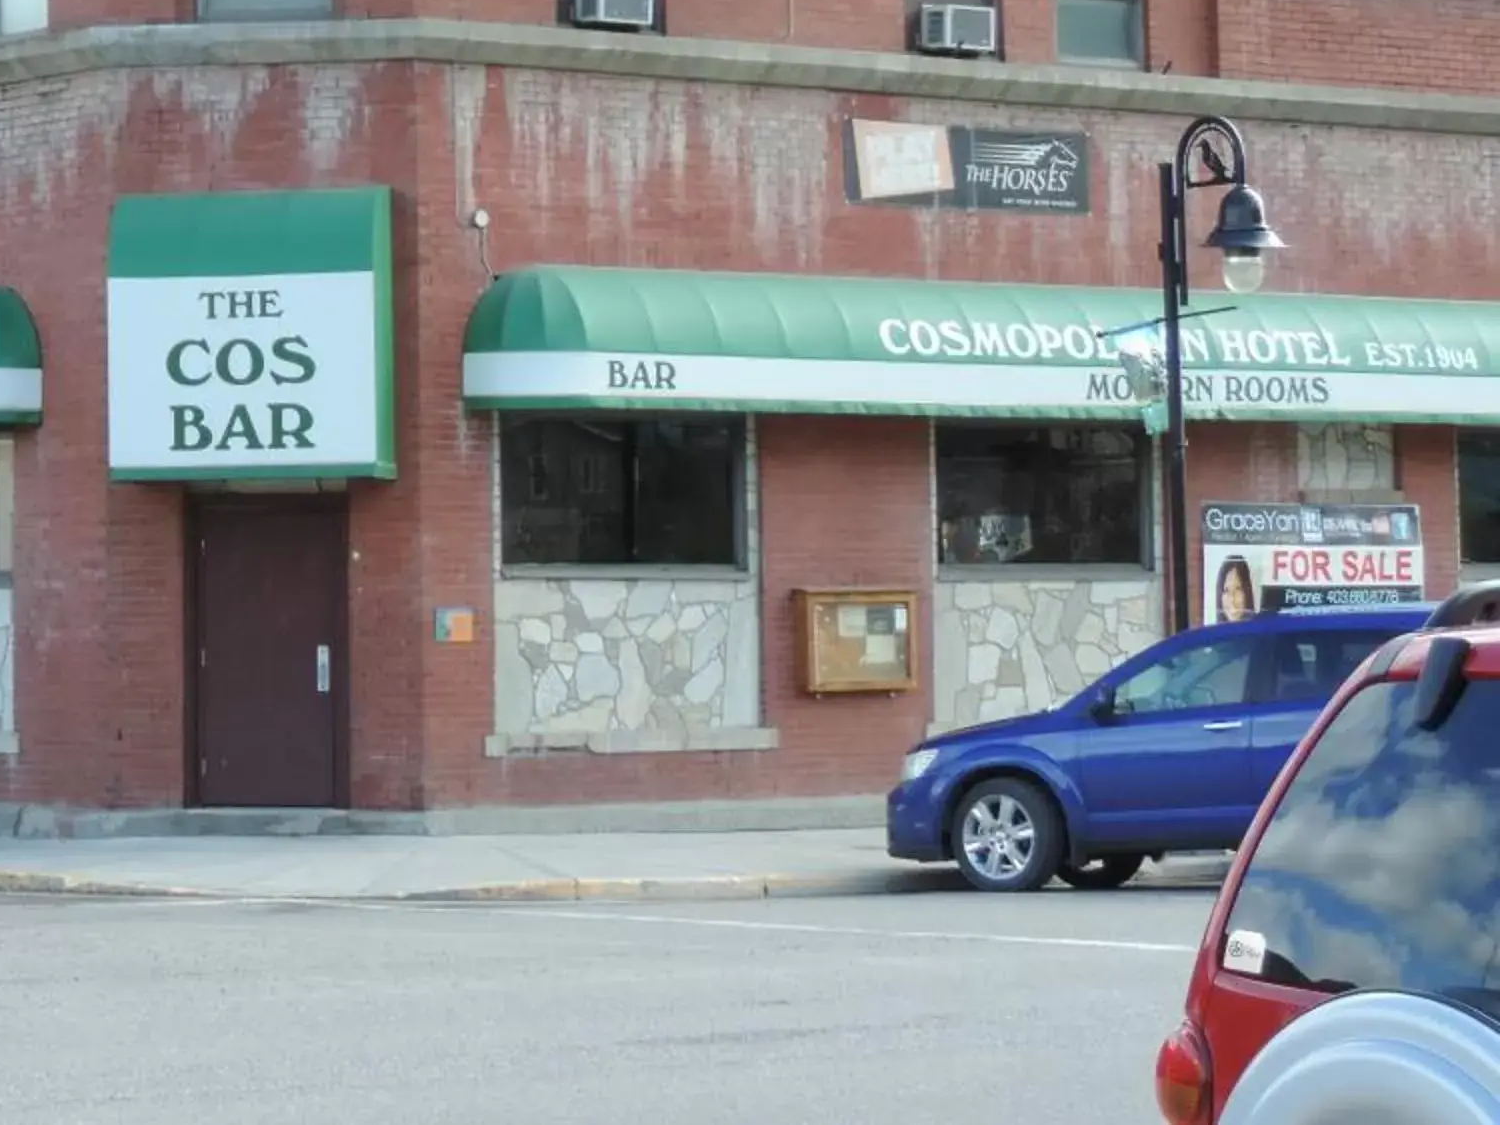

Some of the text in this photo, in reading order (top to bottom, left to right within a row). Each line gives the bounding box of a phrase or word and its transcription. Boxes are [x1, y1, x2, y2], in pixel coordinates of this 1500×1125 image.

[965, 163, 1069, 195] THE HORSES
[197, 289, 284, 320] THE
[878, 317, 1210, 363] COSMOPOLN
[1220, 329, 1353, 366] HOTEL
[165, 334, 317, 386] COS
[607, 360, 676, 390] BAR
[1086, 373, 1330, 404] MORN ROOMS
[168, 402, 316, 452] BAR
[1272, 550, 1413, 582] FOR SALE
